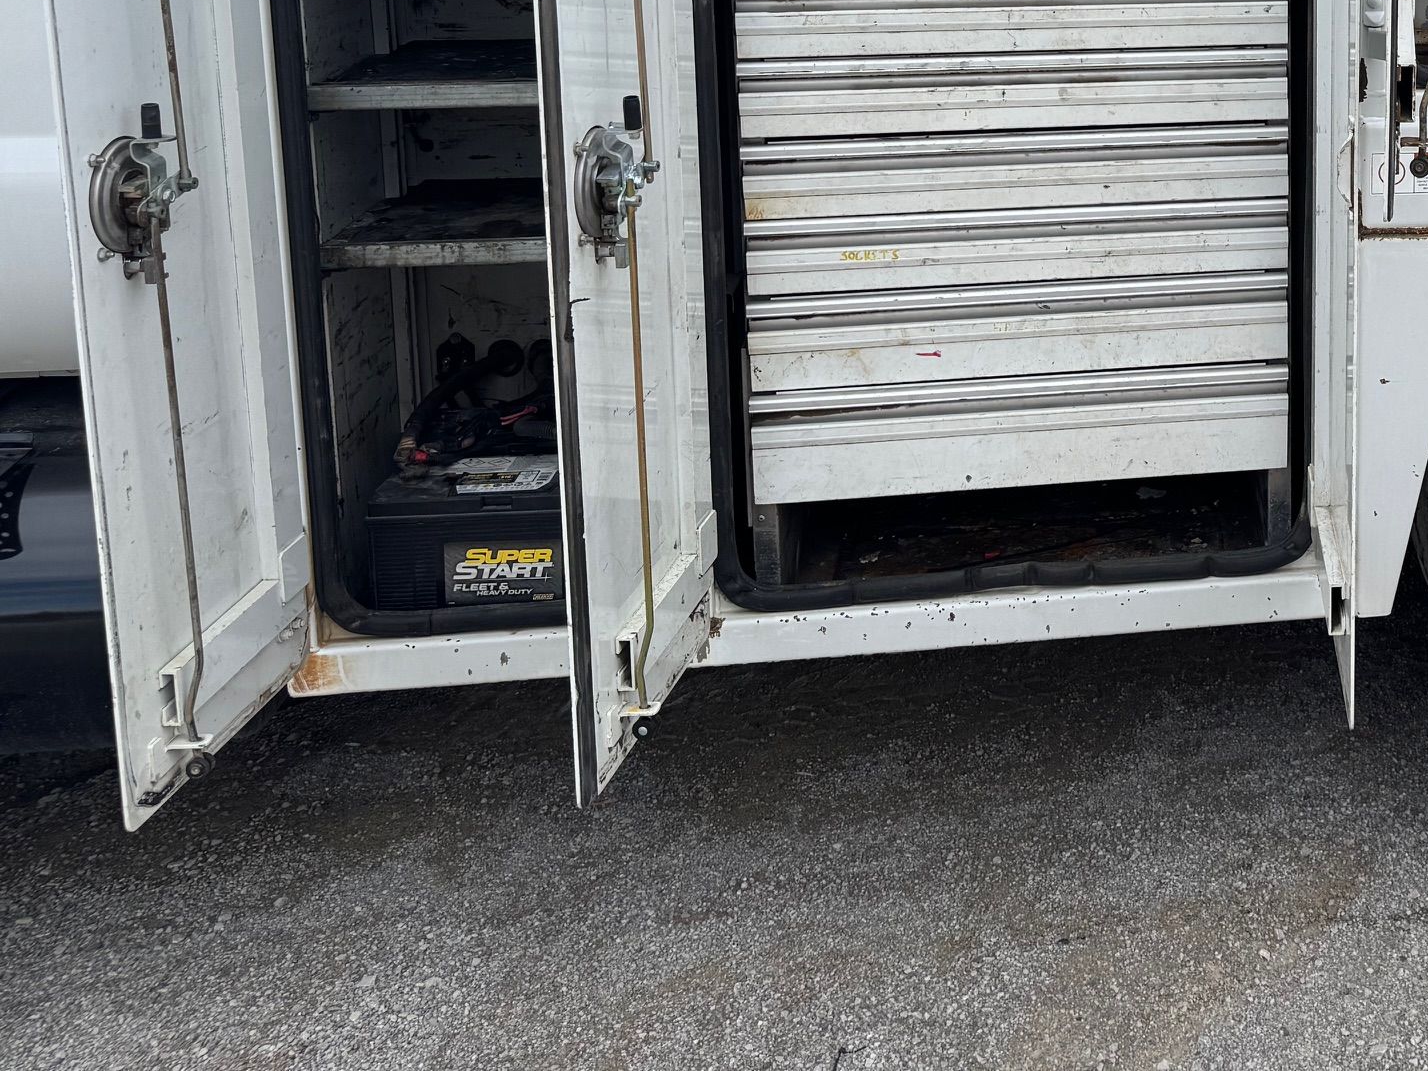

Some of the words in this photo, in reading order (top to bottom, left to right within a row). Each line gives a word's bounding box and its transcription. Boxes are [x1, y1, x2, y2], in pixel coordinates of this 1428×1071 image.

[465, 548, 553, 565] SUPER
[453, 561, 554, 580] START
[453, 582, 497, 592] FLEET
[499, 582, 509, 590] &
[476, 589, 507, 597] HEAVY
